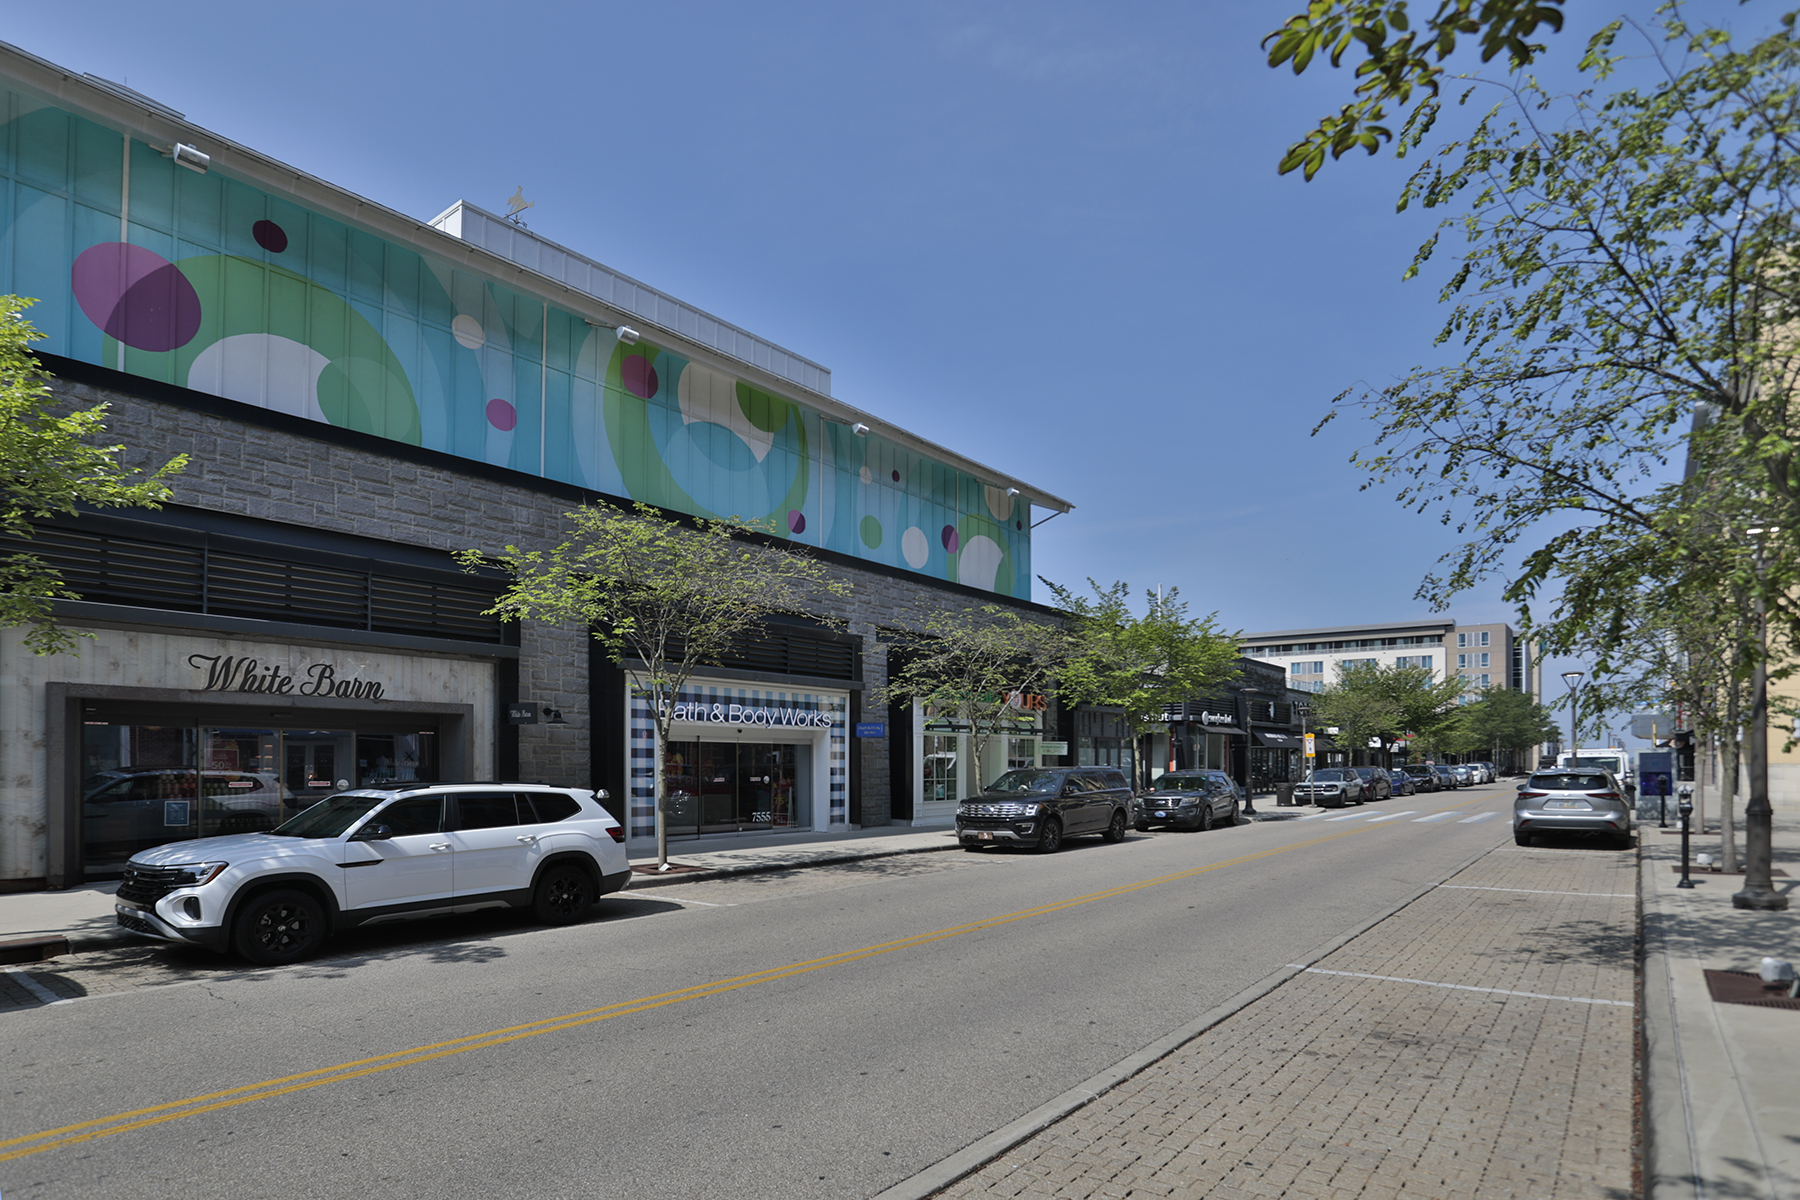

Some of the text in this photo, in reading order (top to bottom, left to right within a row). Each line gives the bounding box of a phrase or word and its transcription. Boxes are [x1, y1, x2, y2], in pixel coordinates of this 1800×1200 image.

[188, 654, 385, 700] White Barn
[710, 703, 725, 723] &
[729, 704, 776, 729] Body
[779, 707, 832, 728] Works
[752, 811, 771, 822] 7555
